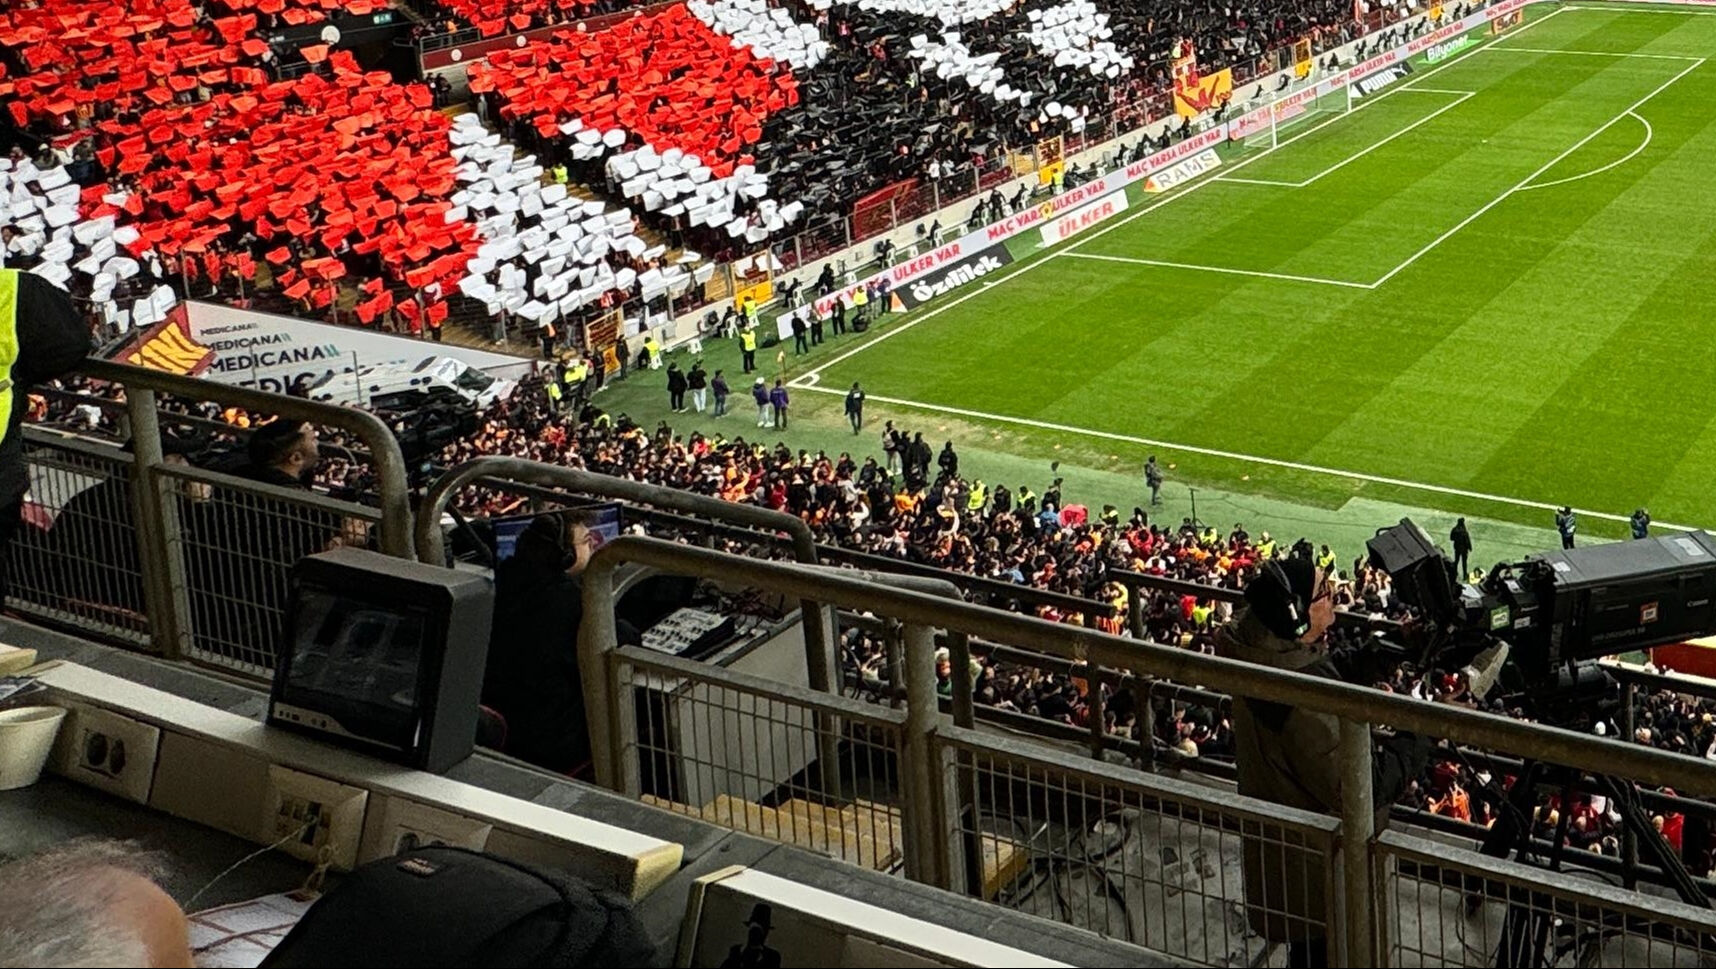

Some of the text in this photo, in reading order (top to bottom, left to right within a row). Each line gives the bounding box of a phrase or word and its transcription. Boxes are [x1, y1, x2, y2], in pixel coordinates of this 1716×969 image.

[1426, 34, 1469, 62] Bilyoner
[1126, 129, 1221, 179] MAÇ VARSA ÜLKER VAR
[1157, 152, 1217, 188] RAMS
[987, 220, 1016, 240] MAÇ
[1084, 181, 1105, 197] VAR
[1059, 202, 1113, 238] ÜLKER
[893, 256, 933, 282] ÜLKER
[936, 243, 960, 263] VAR
[910, 255, 1002, 302] Özdilek
[200, 323, 252, 336] MEDICANA
[203, 334, 282, 352] MEDICANA
[209, 346, 326, 374] MEDICANA
